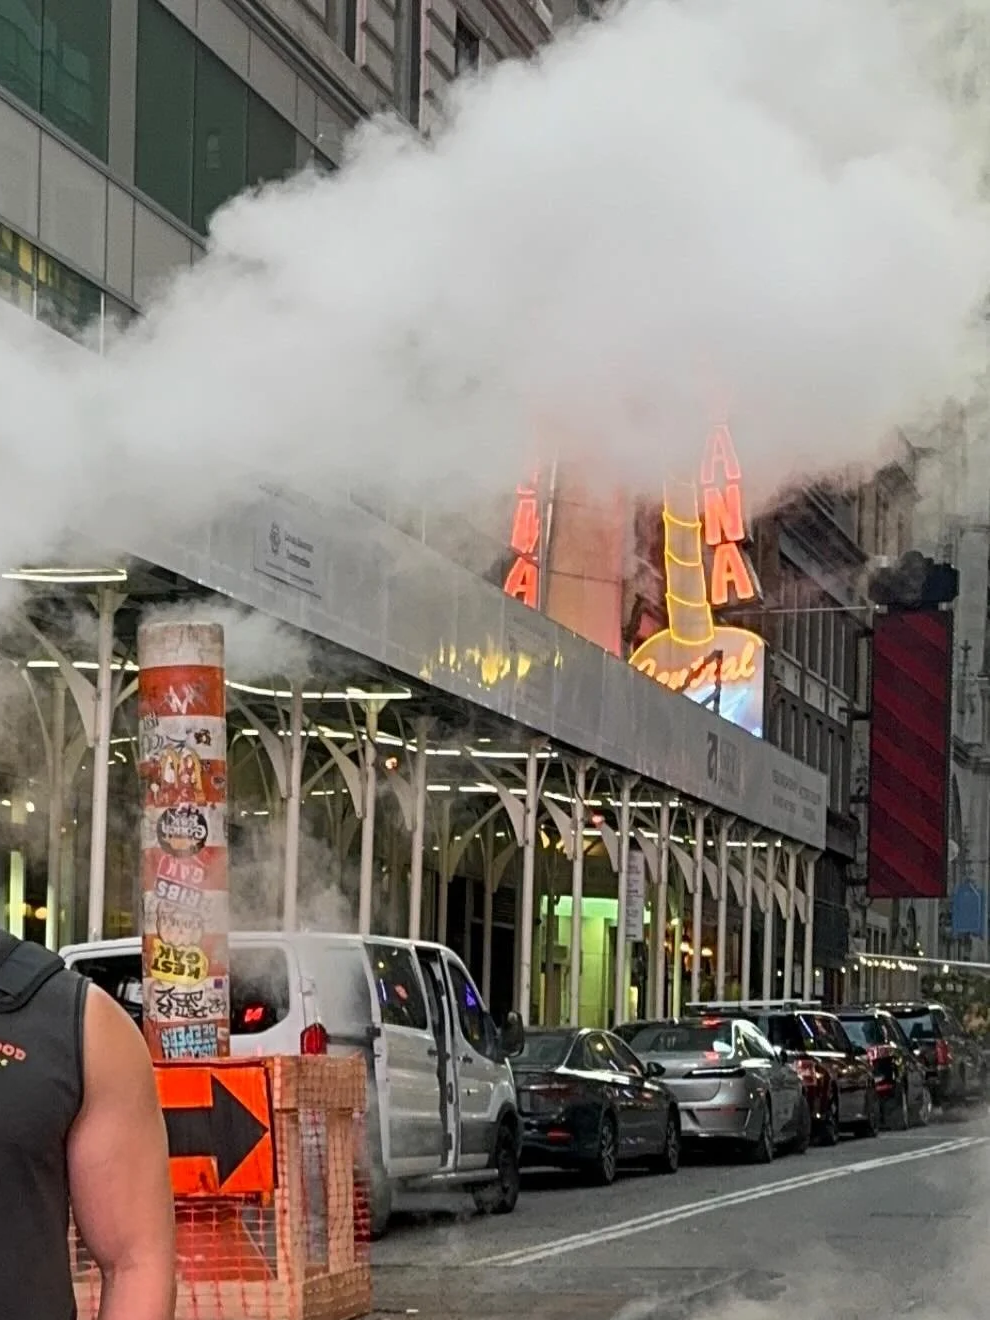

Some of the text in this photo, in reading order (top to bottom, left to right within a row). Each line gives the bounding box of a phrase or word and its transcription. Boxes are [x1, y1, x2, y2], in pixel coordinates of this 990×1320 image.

[156, 880, 201, 905] RIBS
[158, 946, 201, 964] GAK
[151, 959, 201, 980] KEST
